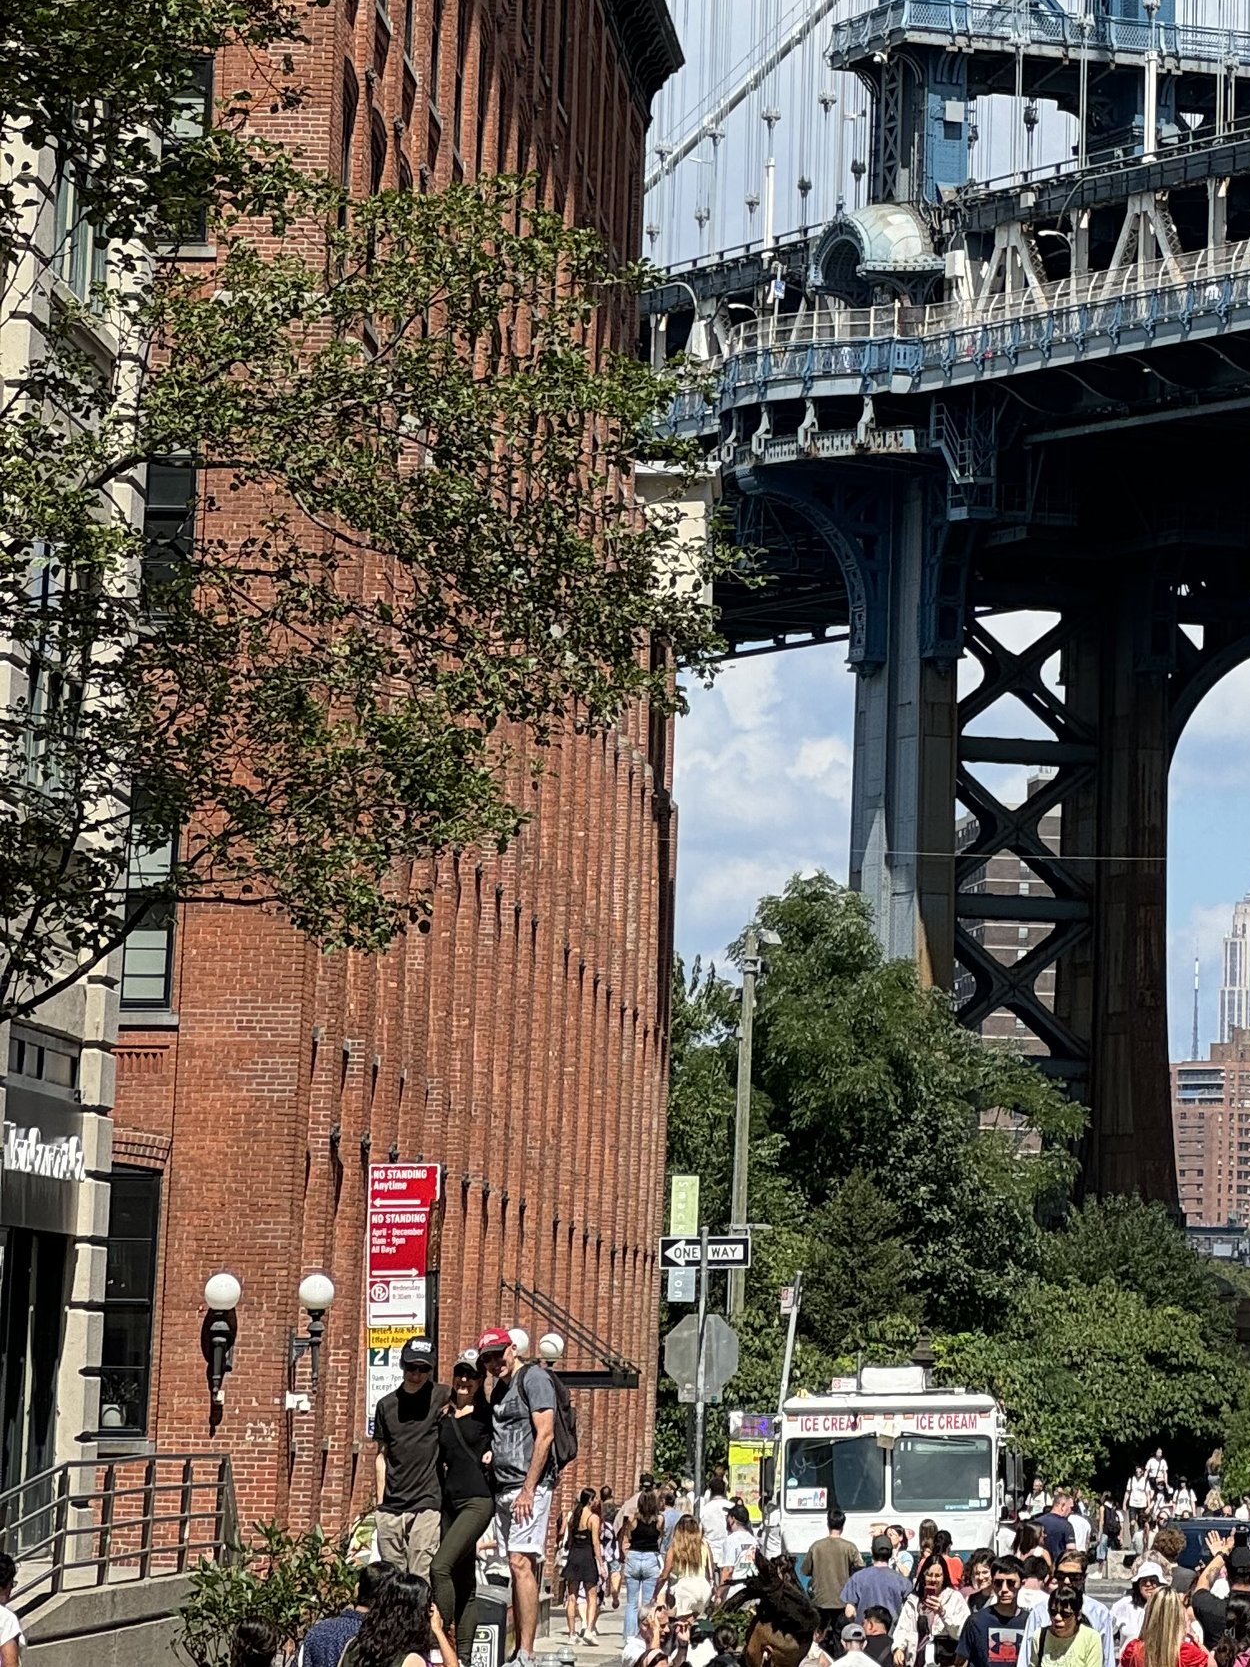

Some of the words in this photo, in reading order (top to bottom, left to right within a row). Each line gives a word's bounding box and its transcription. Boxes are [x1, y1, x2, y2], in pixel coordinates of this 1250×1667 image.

[373, 1169, 385, 1179] NO
[387, 1169, 427, 1180] STANDING
[373, 1180, 407, 1192] Anytime
[371, 1214, 384, 1224] NO
[385, 1213, 427, 1224] STANDING
[372, 1228, 387, 1237] April
[392, 1228, 424, 1236] December
[391, 1237, 406, 1246] 9pm
[371, 1245, 380, 1253] All
[381, 1245, 396, 1254] Days
[673, 1247, 699, 1259] ONE
[711, 1246, 738, 1259] WAY
[372, 1336, 390, 1344] Effect
[373, 1348, 385, 1366] 2
[801, 1417, 819, 1432] ICE
[823, 1416, 862, 1432] CREAM
[916, 1415, 934, 1430] ICE
[938, 1414, 977, 1430] CREAM
